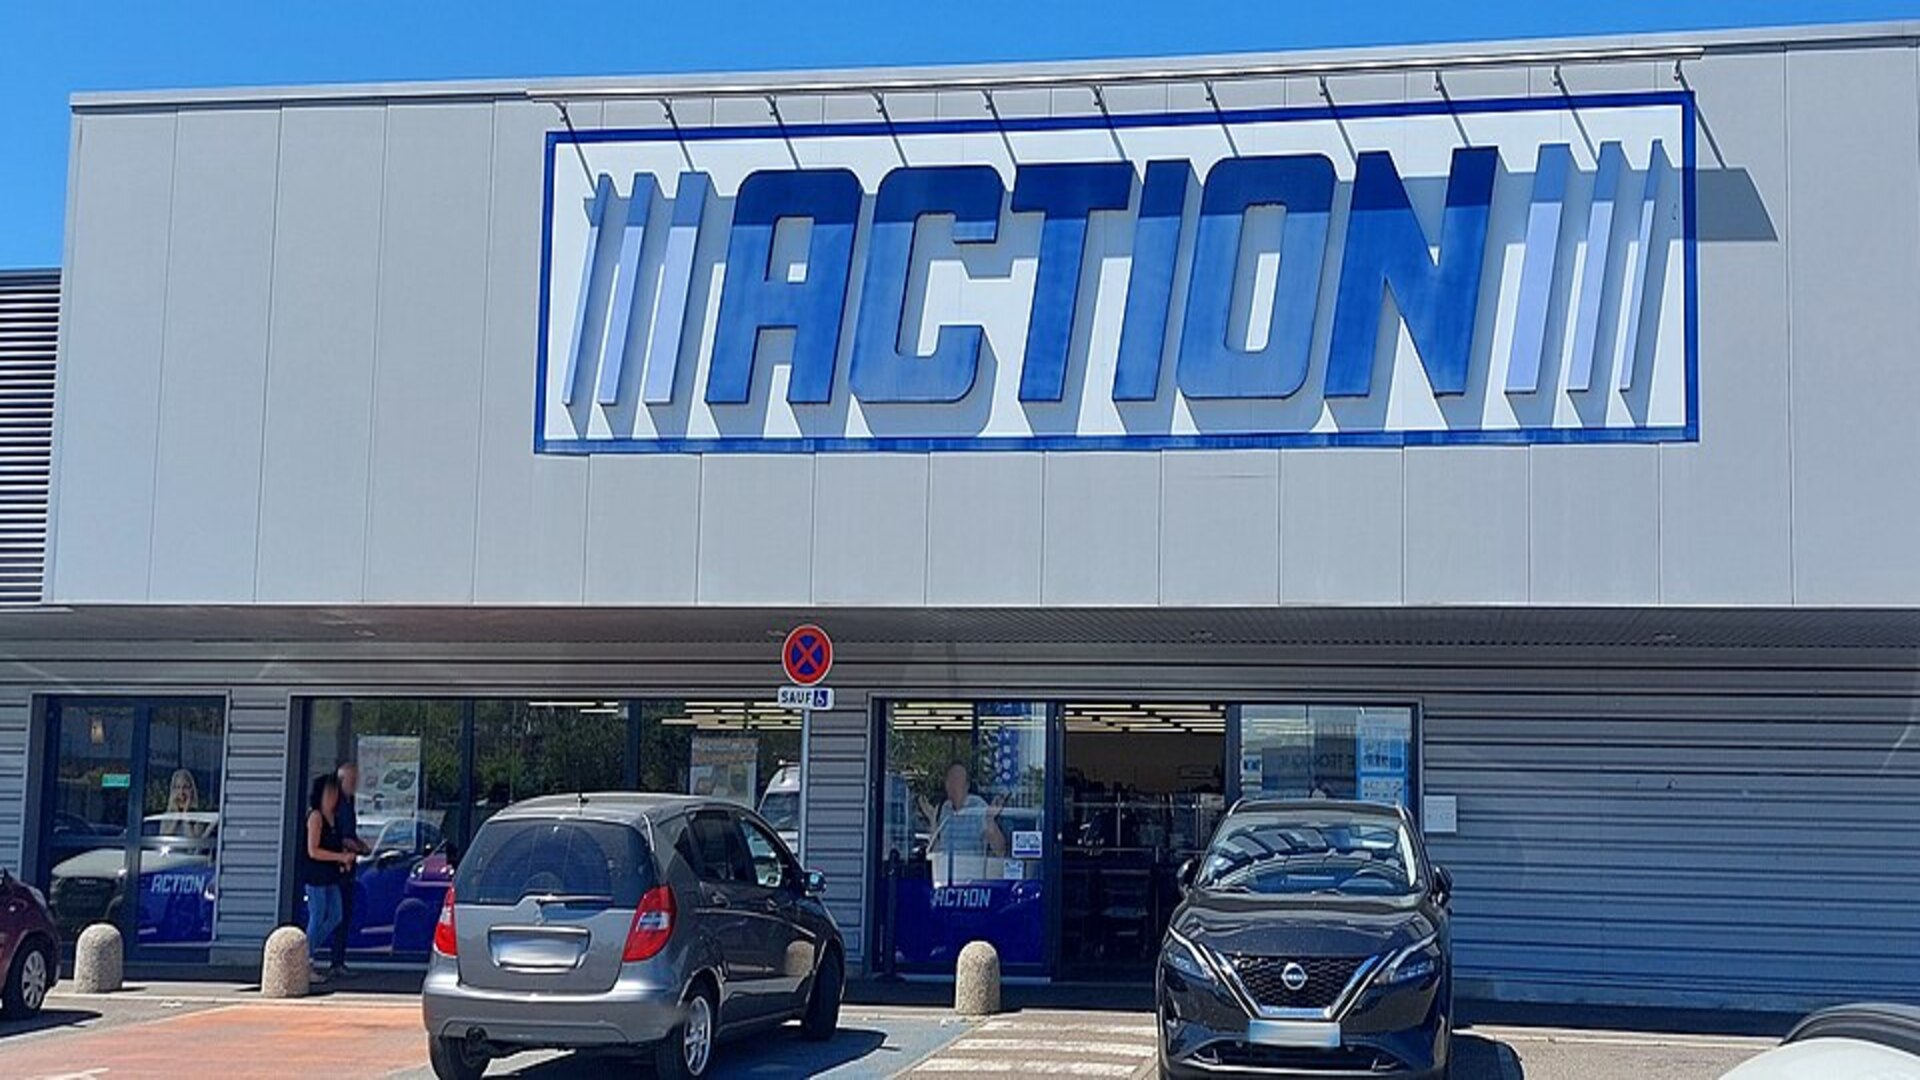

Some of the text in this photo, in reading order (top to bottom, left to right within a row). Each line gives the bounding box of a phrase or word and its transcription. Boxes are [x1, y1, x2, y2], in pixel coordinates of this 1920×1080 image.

[705, 146, 1498, 403] ACTION
[781, 690, 812, 704] SAUF
[151, 874, 204, 893] ACTION
[932, 888, 991, 907] ACTION
